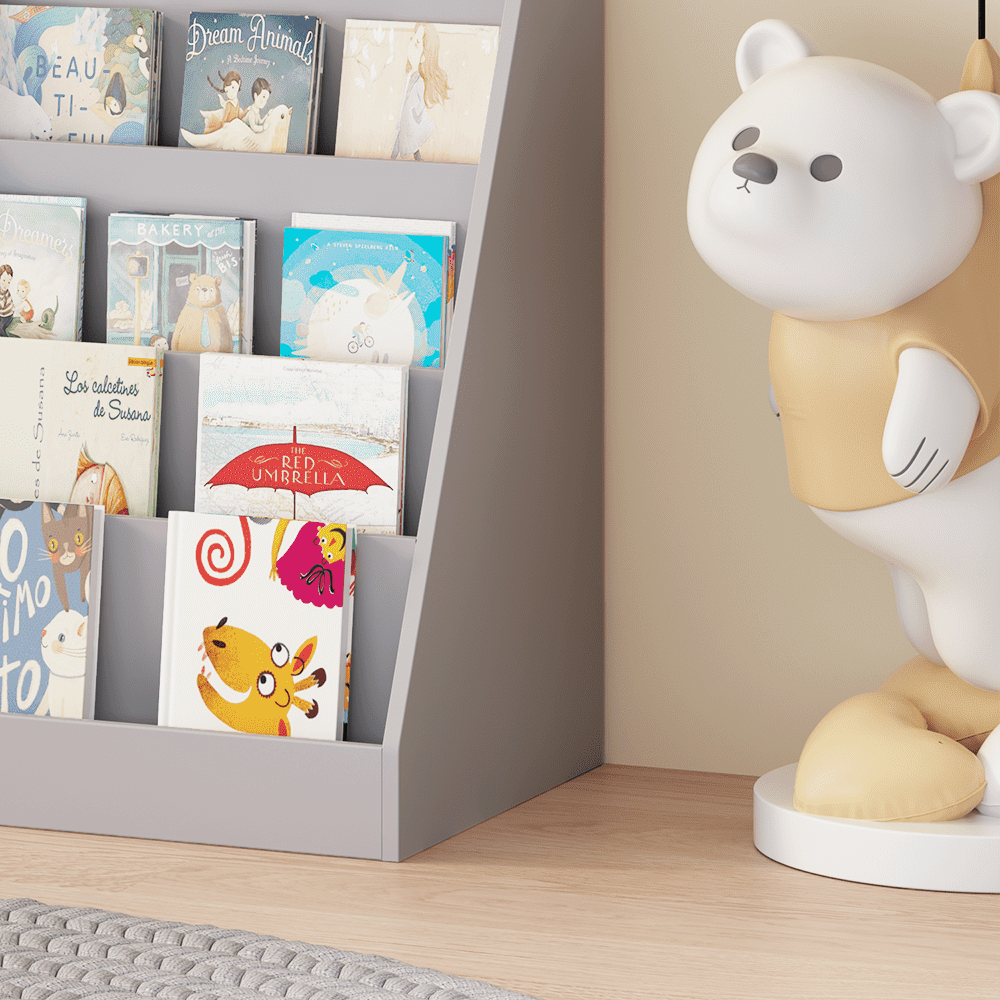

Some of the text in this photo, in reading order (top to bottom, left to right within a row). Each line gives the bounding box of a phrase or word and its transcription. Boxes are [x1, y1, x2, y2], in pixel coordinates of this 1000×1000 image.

[186, 14, 313, 65] Dream Animals
[137, 222, 204, 237] BAKERY
[63, 370, 139, 397] Los calcetines
[33, 367, 45, 443] Susana
[93, 399, 151, 421] de Susana
[291, 447, 306, 455] THE
[282, 455, 315, 471] RED
[252, 468, 345, 486] UMBRELLA
